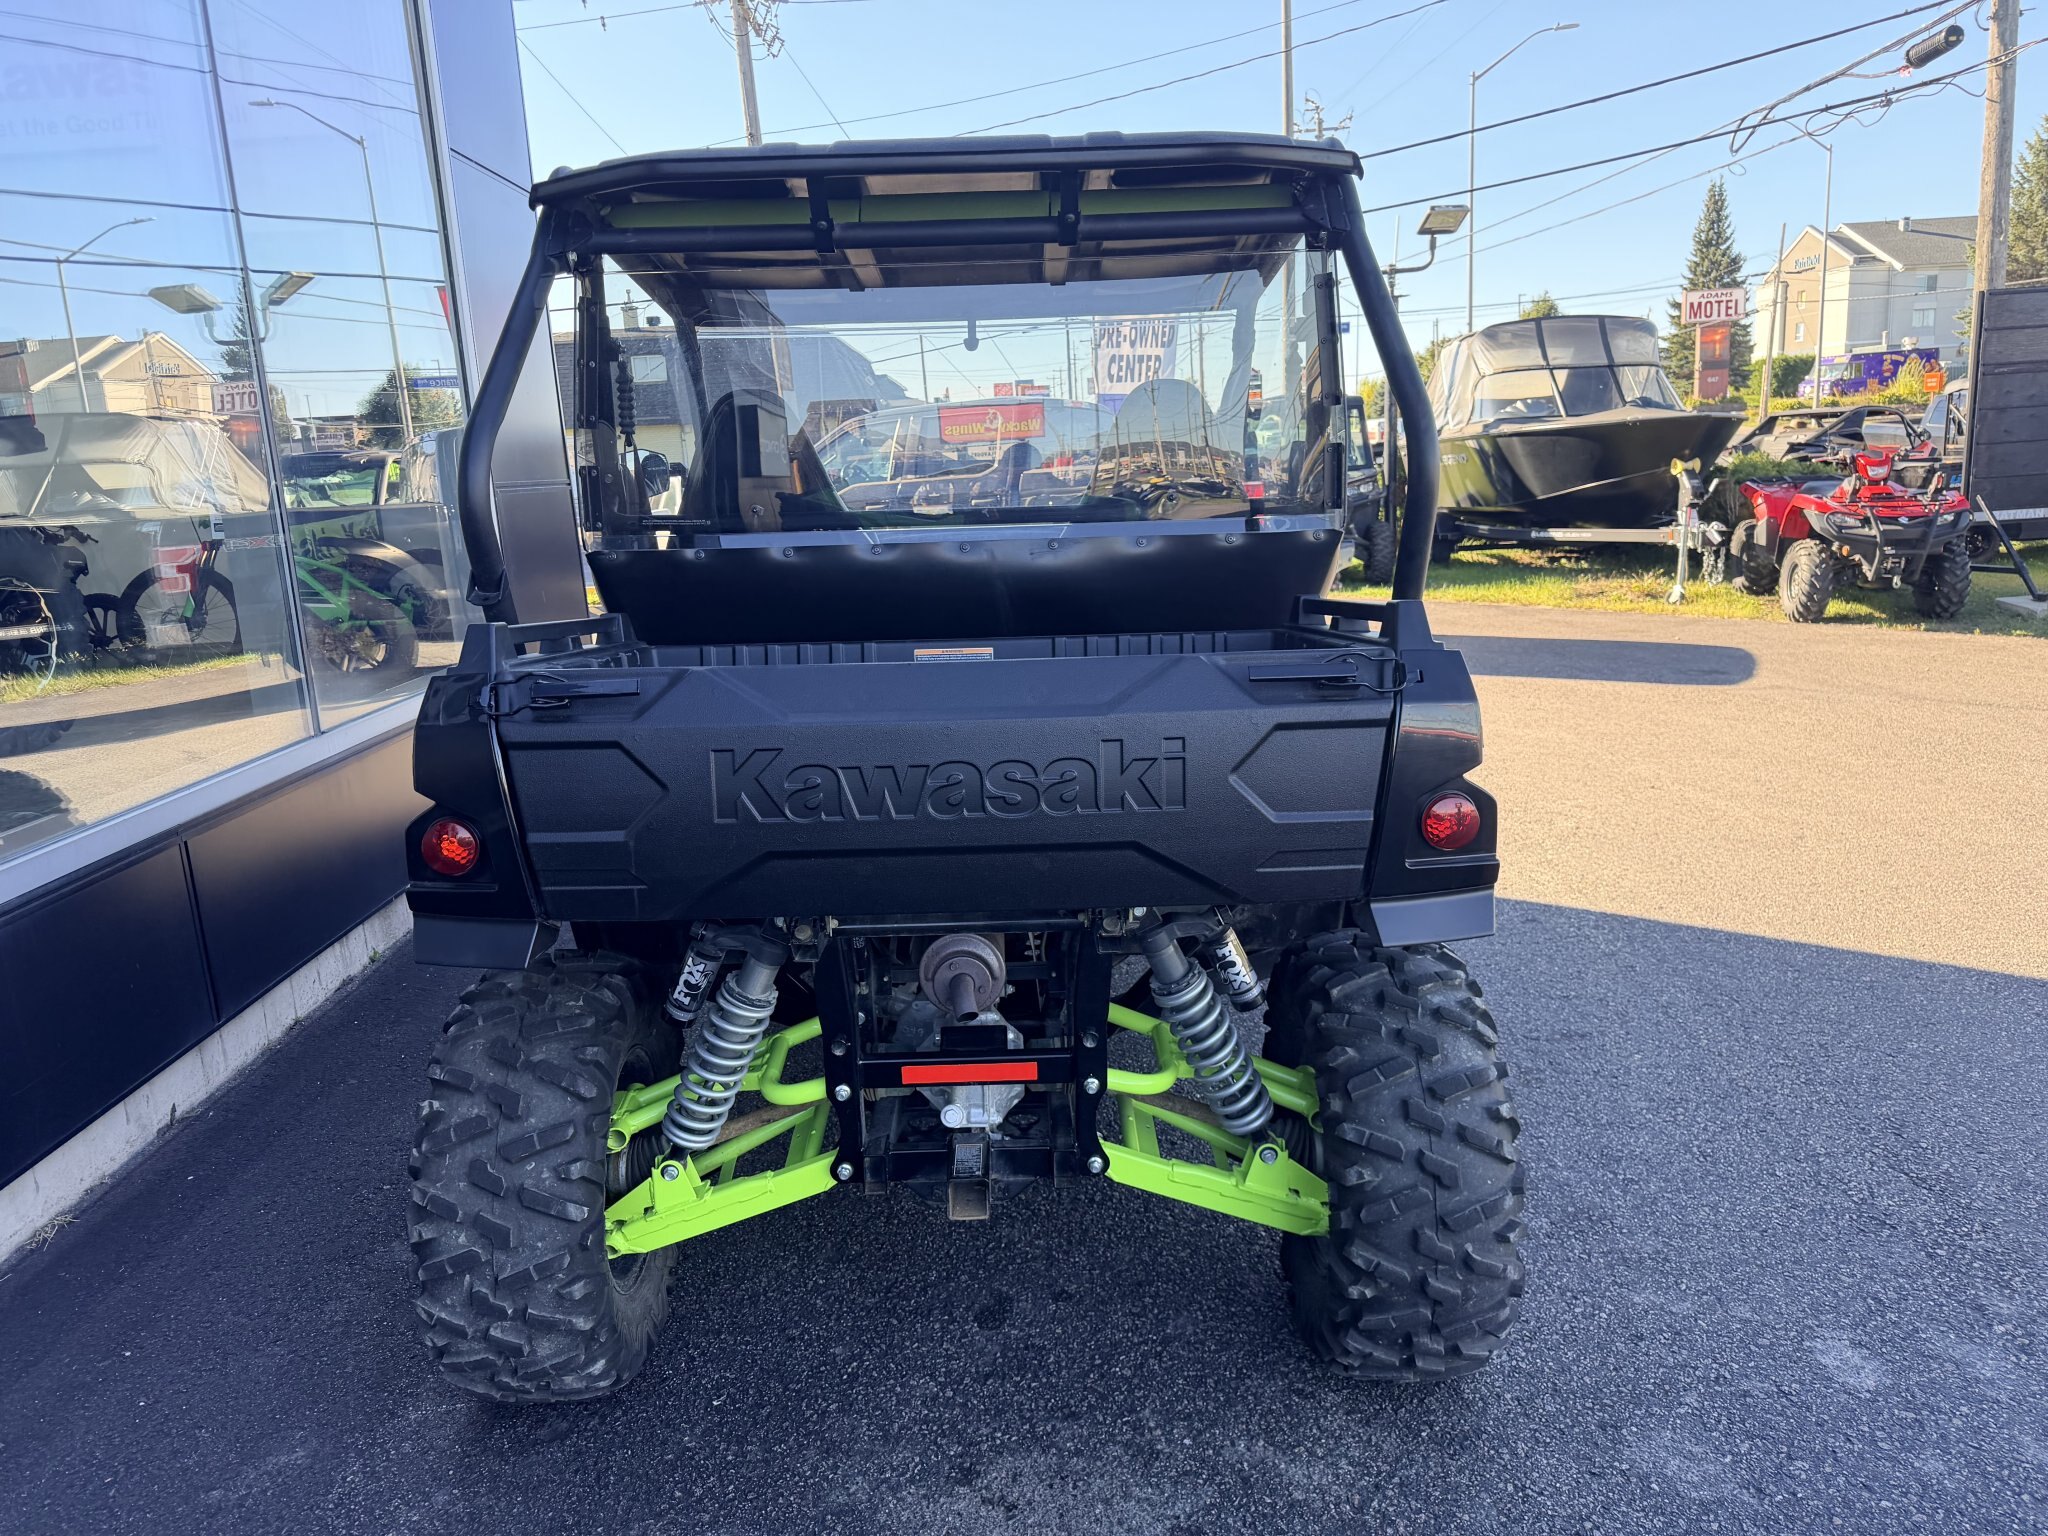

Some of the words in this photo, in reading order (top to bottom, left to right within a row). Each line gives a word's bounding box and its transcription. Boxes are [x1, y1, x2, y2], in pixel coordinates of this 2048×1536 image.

[1688, 299, 1740, 320] MOTEL
[1698, 291, 1733, 300] ADAMS
[1098, 319, 1176, 349] PRE-OWNED
[1107, 353, 1162, 383] CENTER
[709, 736, 1187, 824] Kawasaki
[1215, 941, 1252, 990] FOX
[672, 956, 713, 1006] FOX
